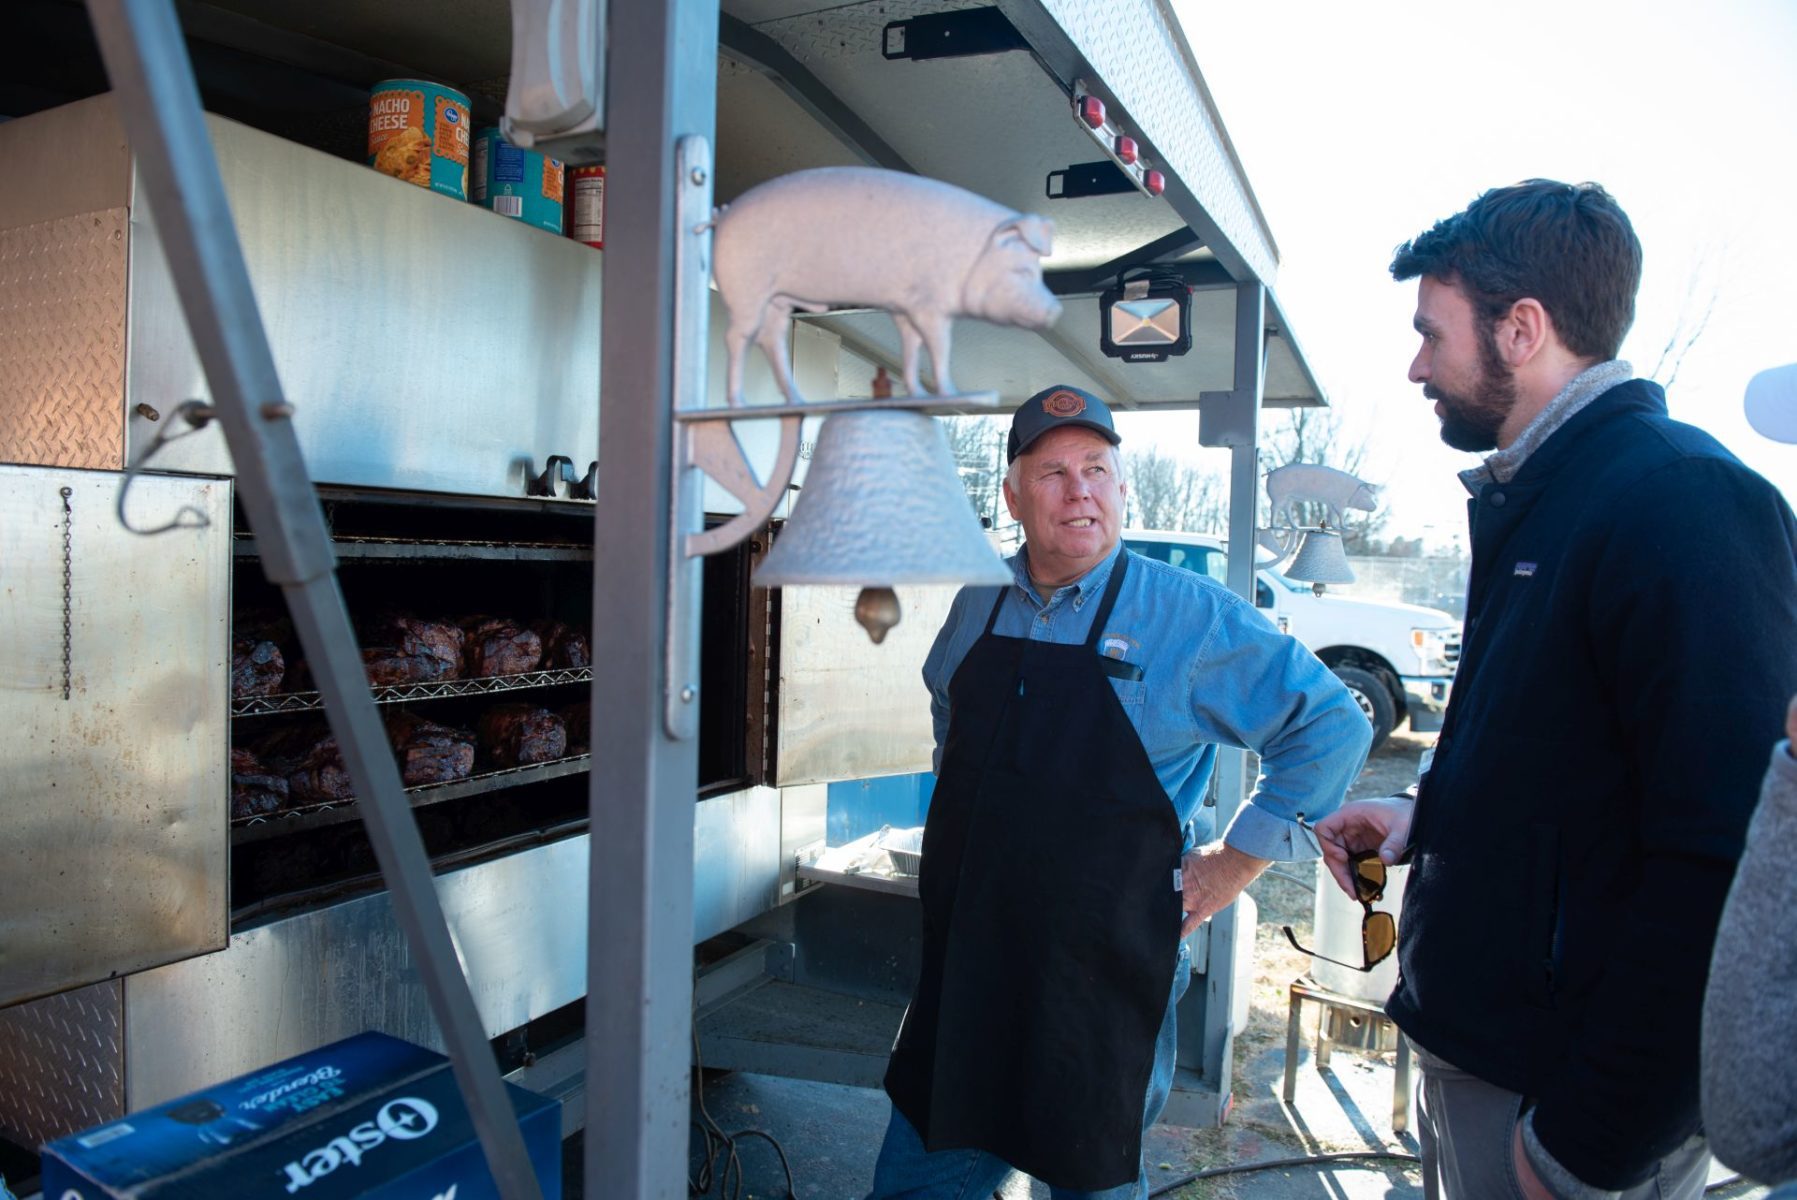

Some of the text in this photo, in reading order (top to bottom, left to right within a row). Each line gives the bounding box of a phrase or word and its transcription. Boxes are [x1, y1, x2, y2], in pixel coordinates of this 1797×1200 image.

[373, 98, 410, 116] NACHO
[370, 114, 409, 133] CHEESE
[239, 1066, 342, 1110] Blender
[283, 1097, 439, 1194] Oster
